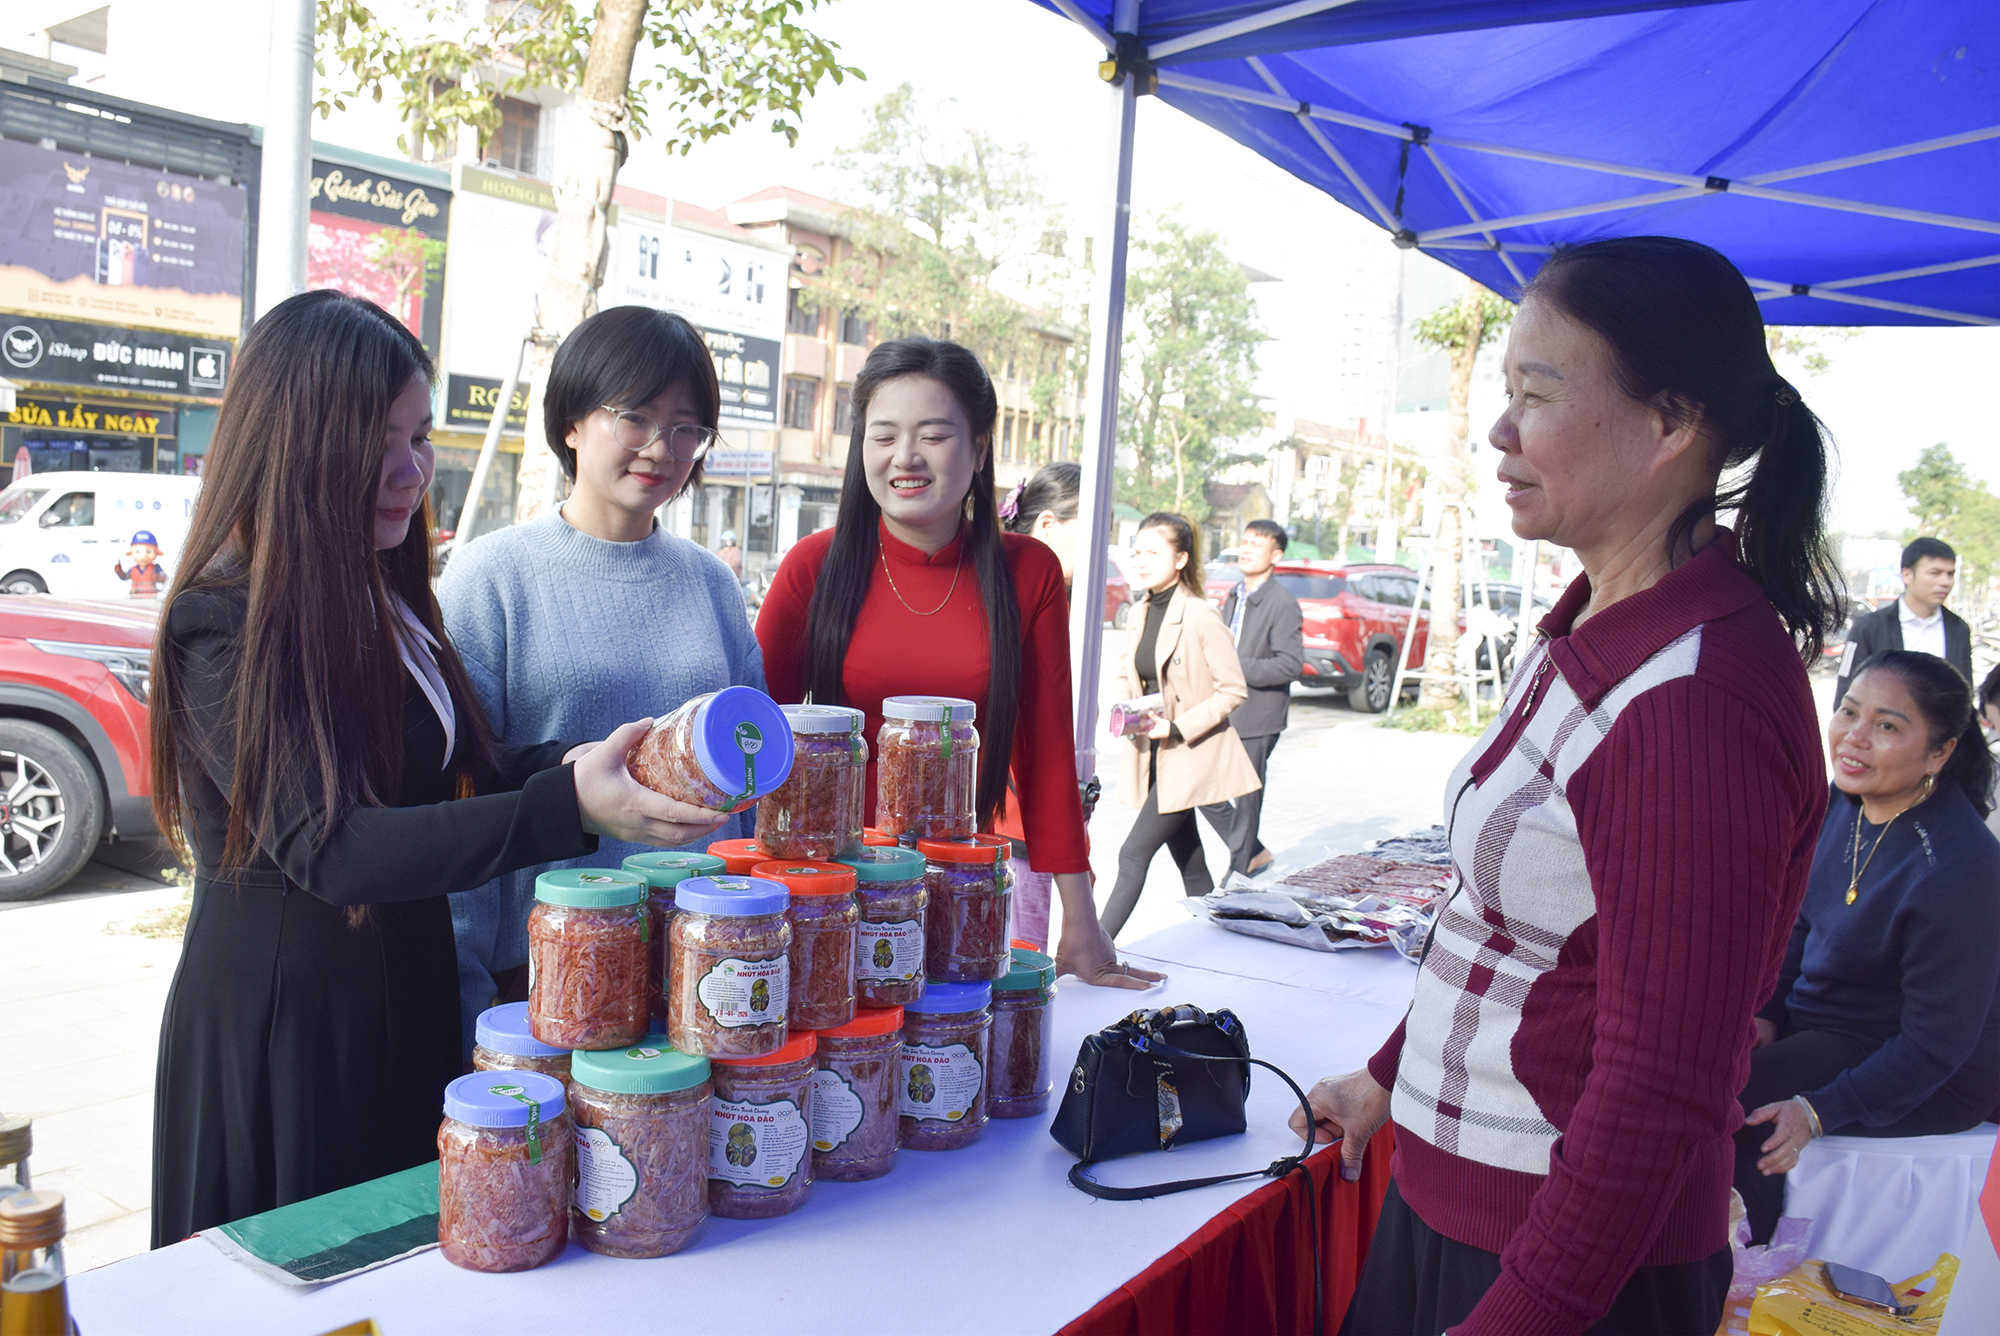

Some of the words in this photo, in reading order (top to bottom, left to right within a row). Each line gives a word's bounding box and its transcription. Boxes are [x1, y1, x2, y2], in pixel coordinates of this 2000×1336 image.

[48, 341, 88, 362] iShop
[93, 340, 132, 364] ĐỨC
[135, 346, 184, 370] HUÂN
[57, 403, 99, 429] LẤY
[104, 413, 160, 434] NGAY
[737, 970, 756, 978] NHÚT
[901, 1054, 915, 1062] HÚT
[821, 1079, 838, 1087] OCOP
[714, 1109, 736, 1120] NHÚT
[777, 1109, 793, 1118] OCOP
[592, 1138, 608, 1147] OCOP
